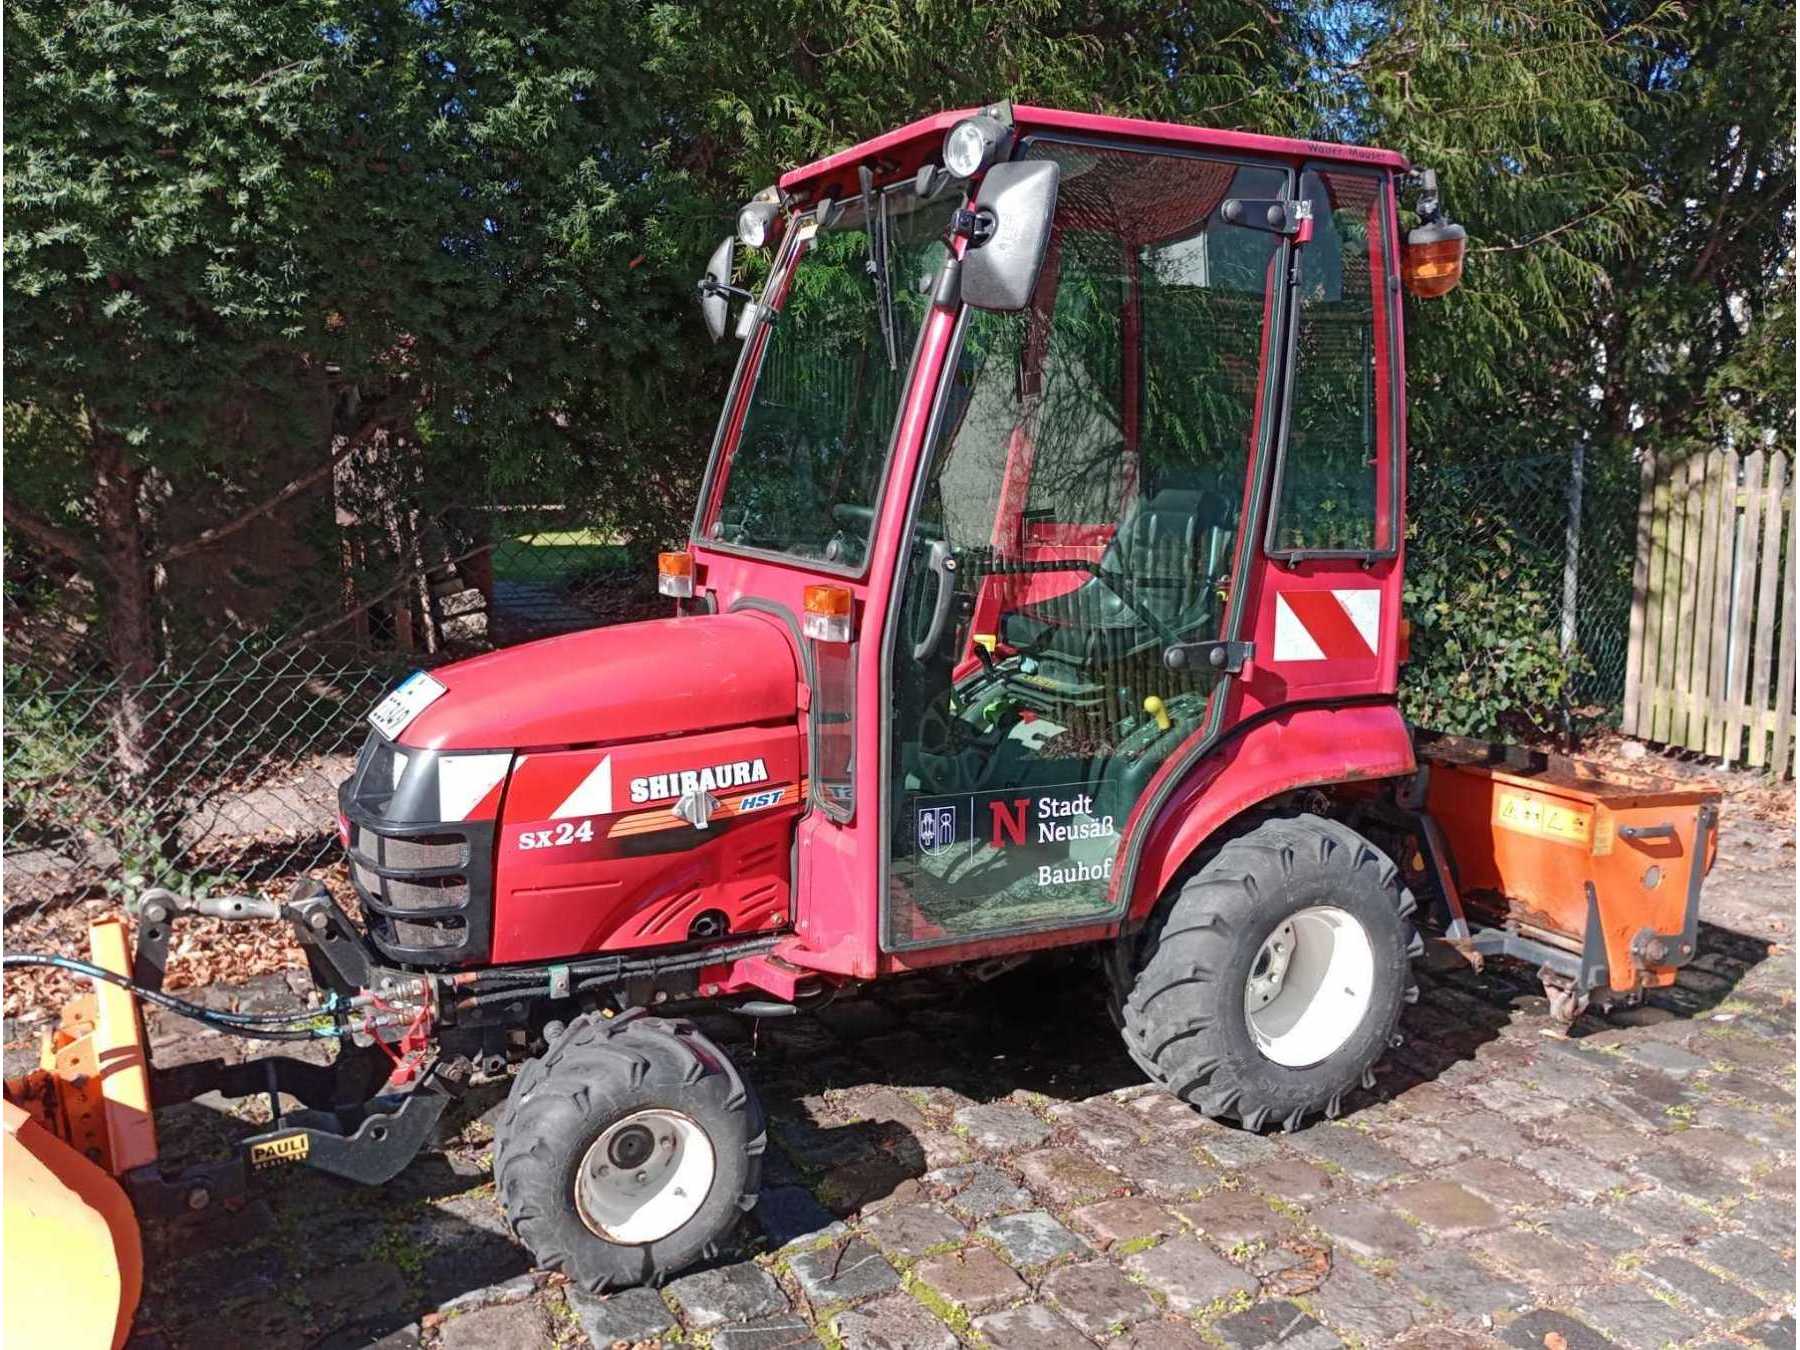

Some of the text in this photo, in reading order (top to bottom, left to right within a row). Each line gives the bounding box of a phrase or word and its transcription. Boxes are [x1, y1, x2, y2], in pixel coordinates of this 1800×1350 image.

[630, 758, 769, 803] SHIBAURA
[740, 789, 785, 811] HST
[1037, 794, 1093, 819] Stadt
[989, 799, 1031, 849] N
[1037, 815, 1115, 844] Neusäß
[1037, 857, 1113, 887] Bauhof
[254, 1138, 305, 1159] PAULI
